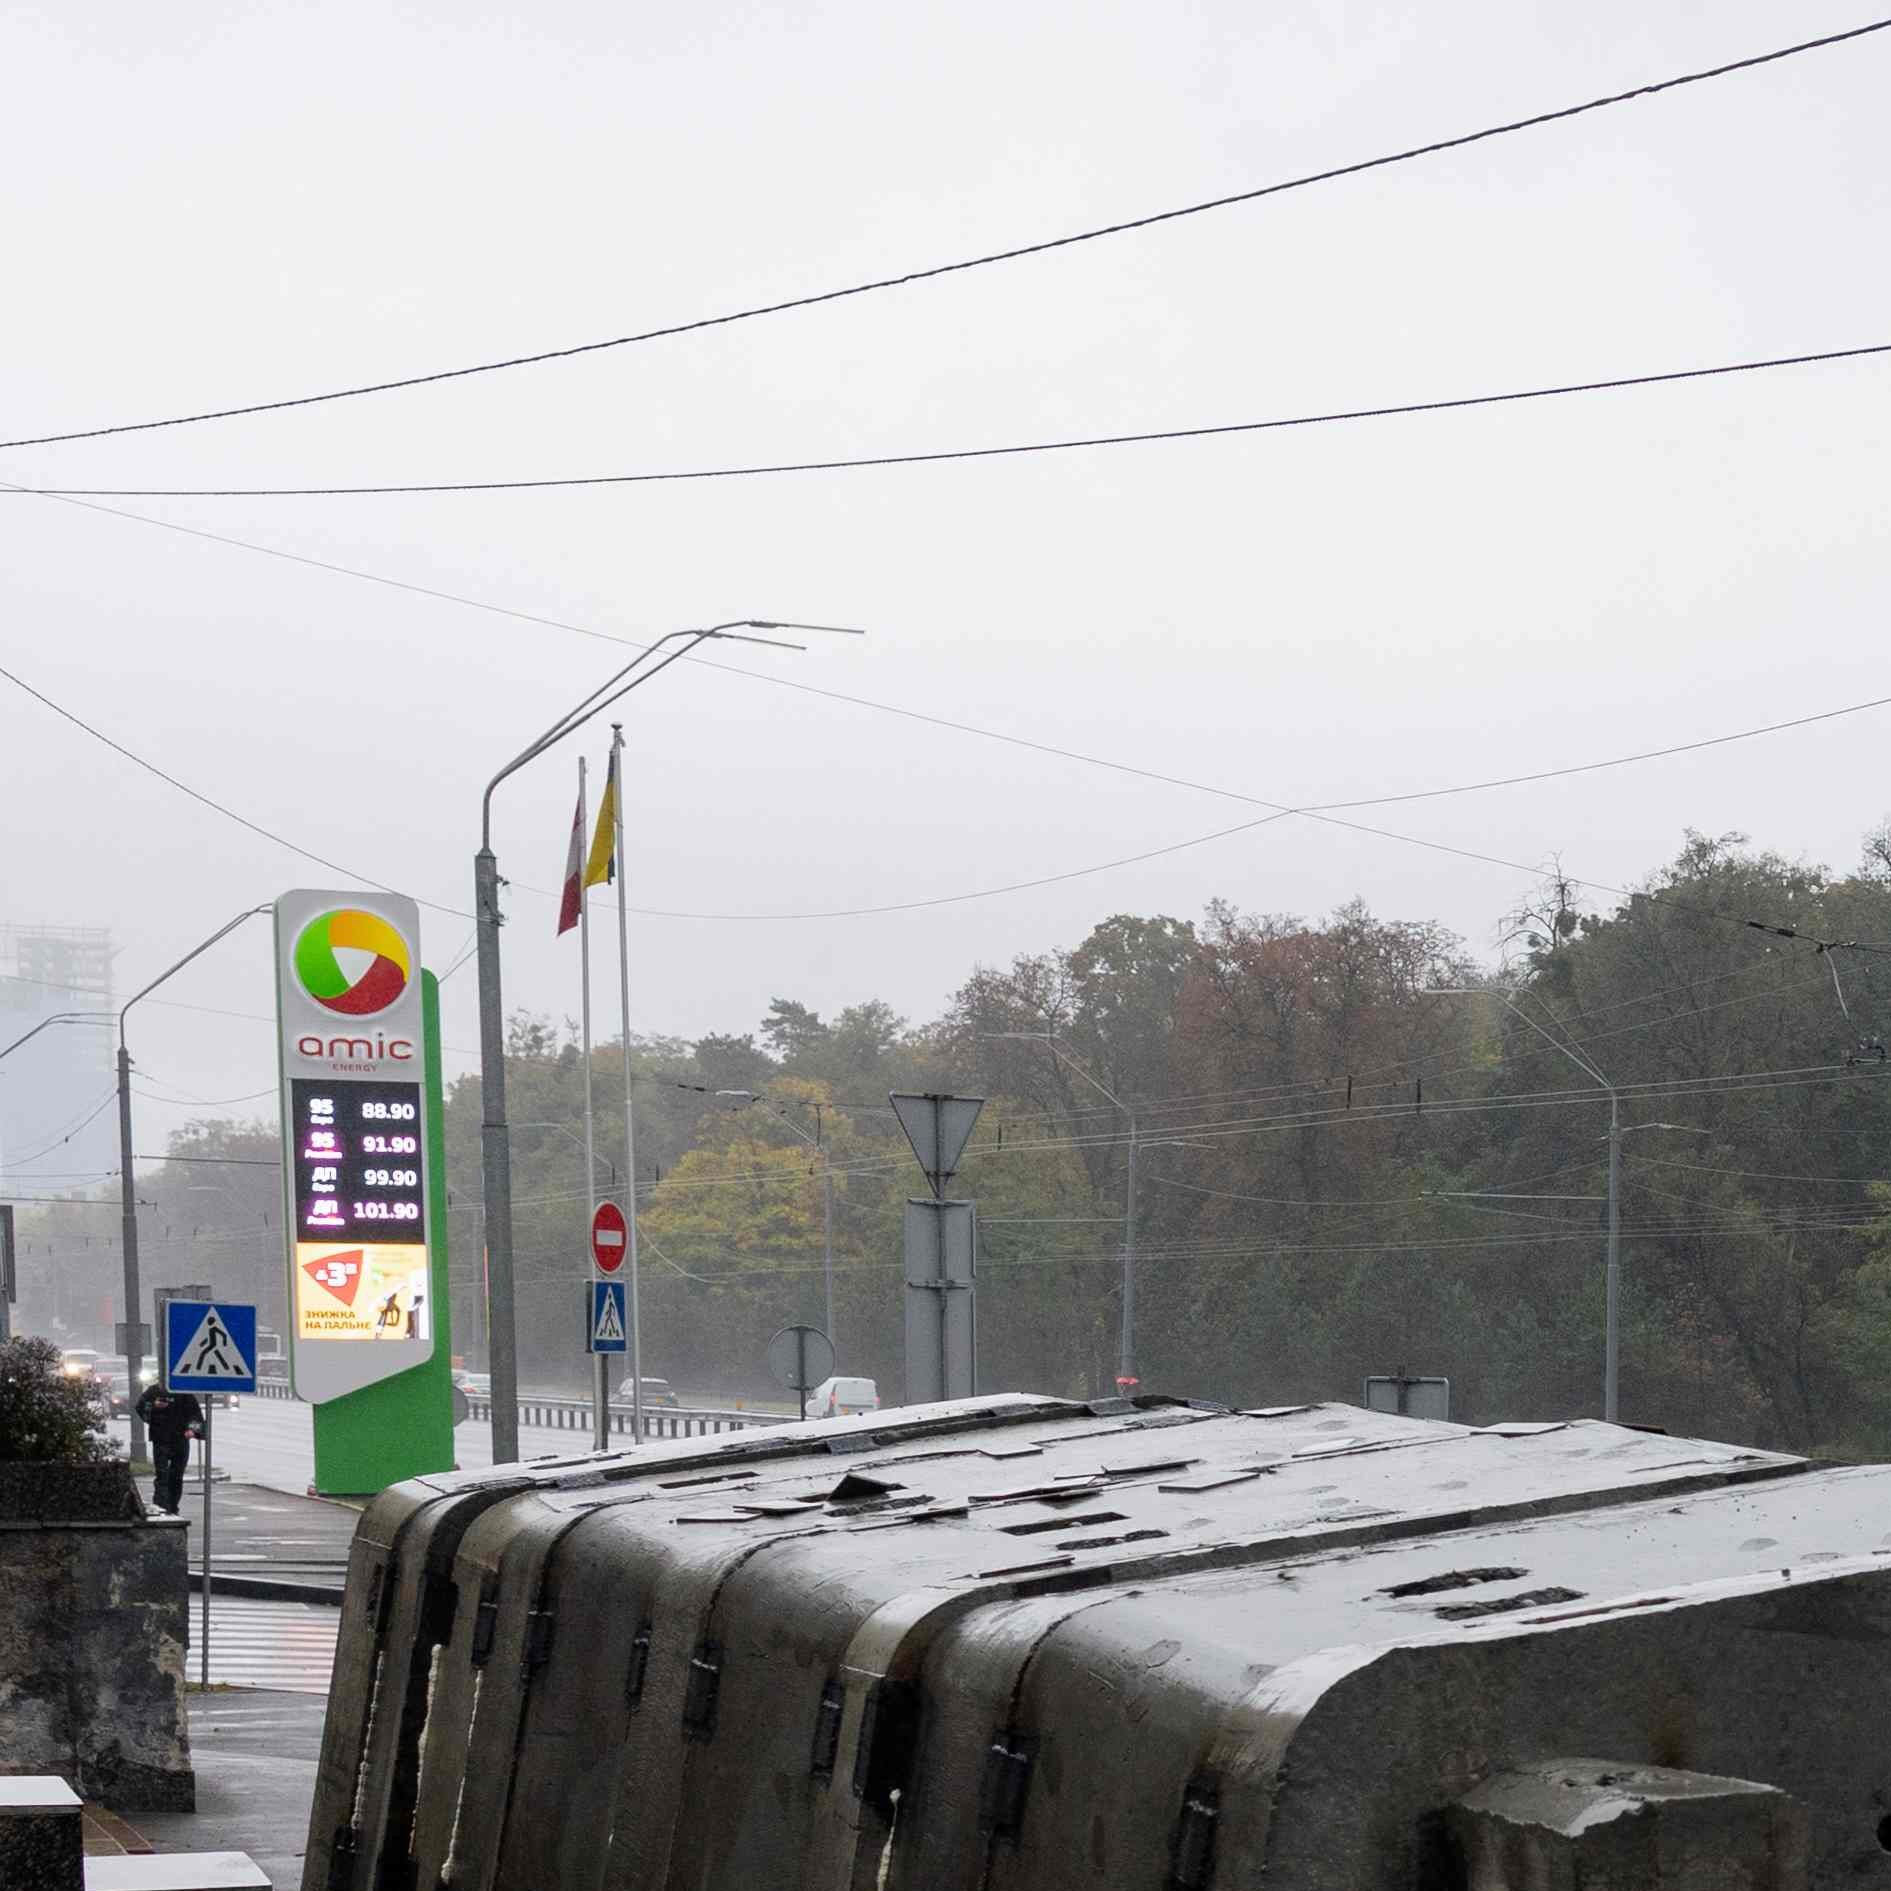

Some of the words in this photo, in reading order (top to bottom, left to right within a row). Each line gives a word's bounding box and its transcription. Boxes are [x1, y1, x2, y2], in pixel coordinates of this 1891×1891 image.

[298, 1032, 413, 1060] amic
[332, 1063, 378, 1072] ENERGY
[362, 1102, 415, 1120] 88.90
[363, 1136, 416, 1153] 91.90
[364, 1169, 417, 1186] 99.90
[353, 1202, 419, 1219] 101.90
[304, 1310, 356, 1319] ЗНИЖКА
